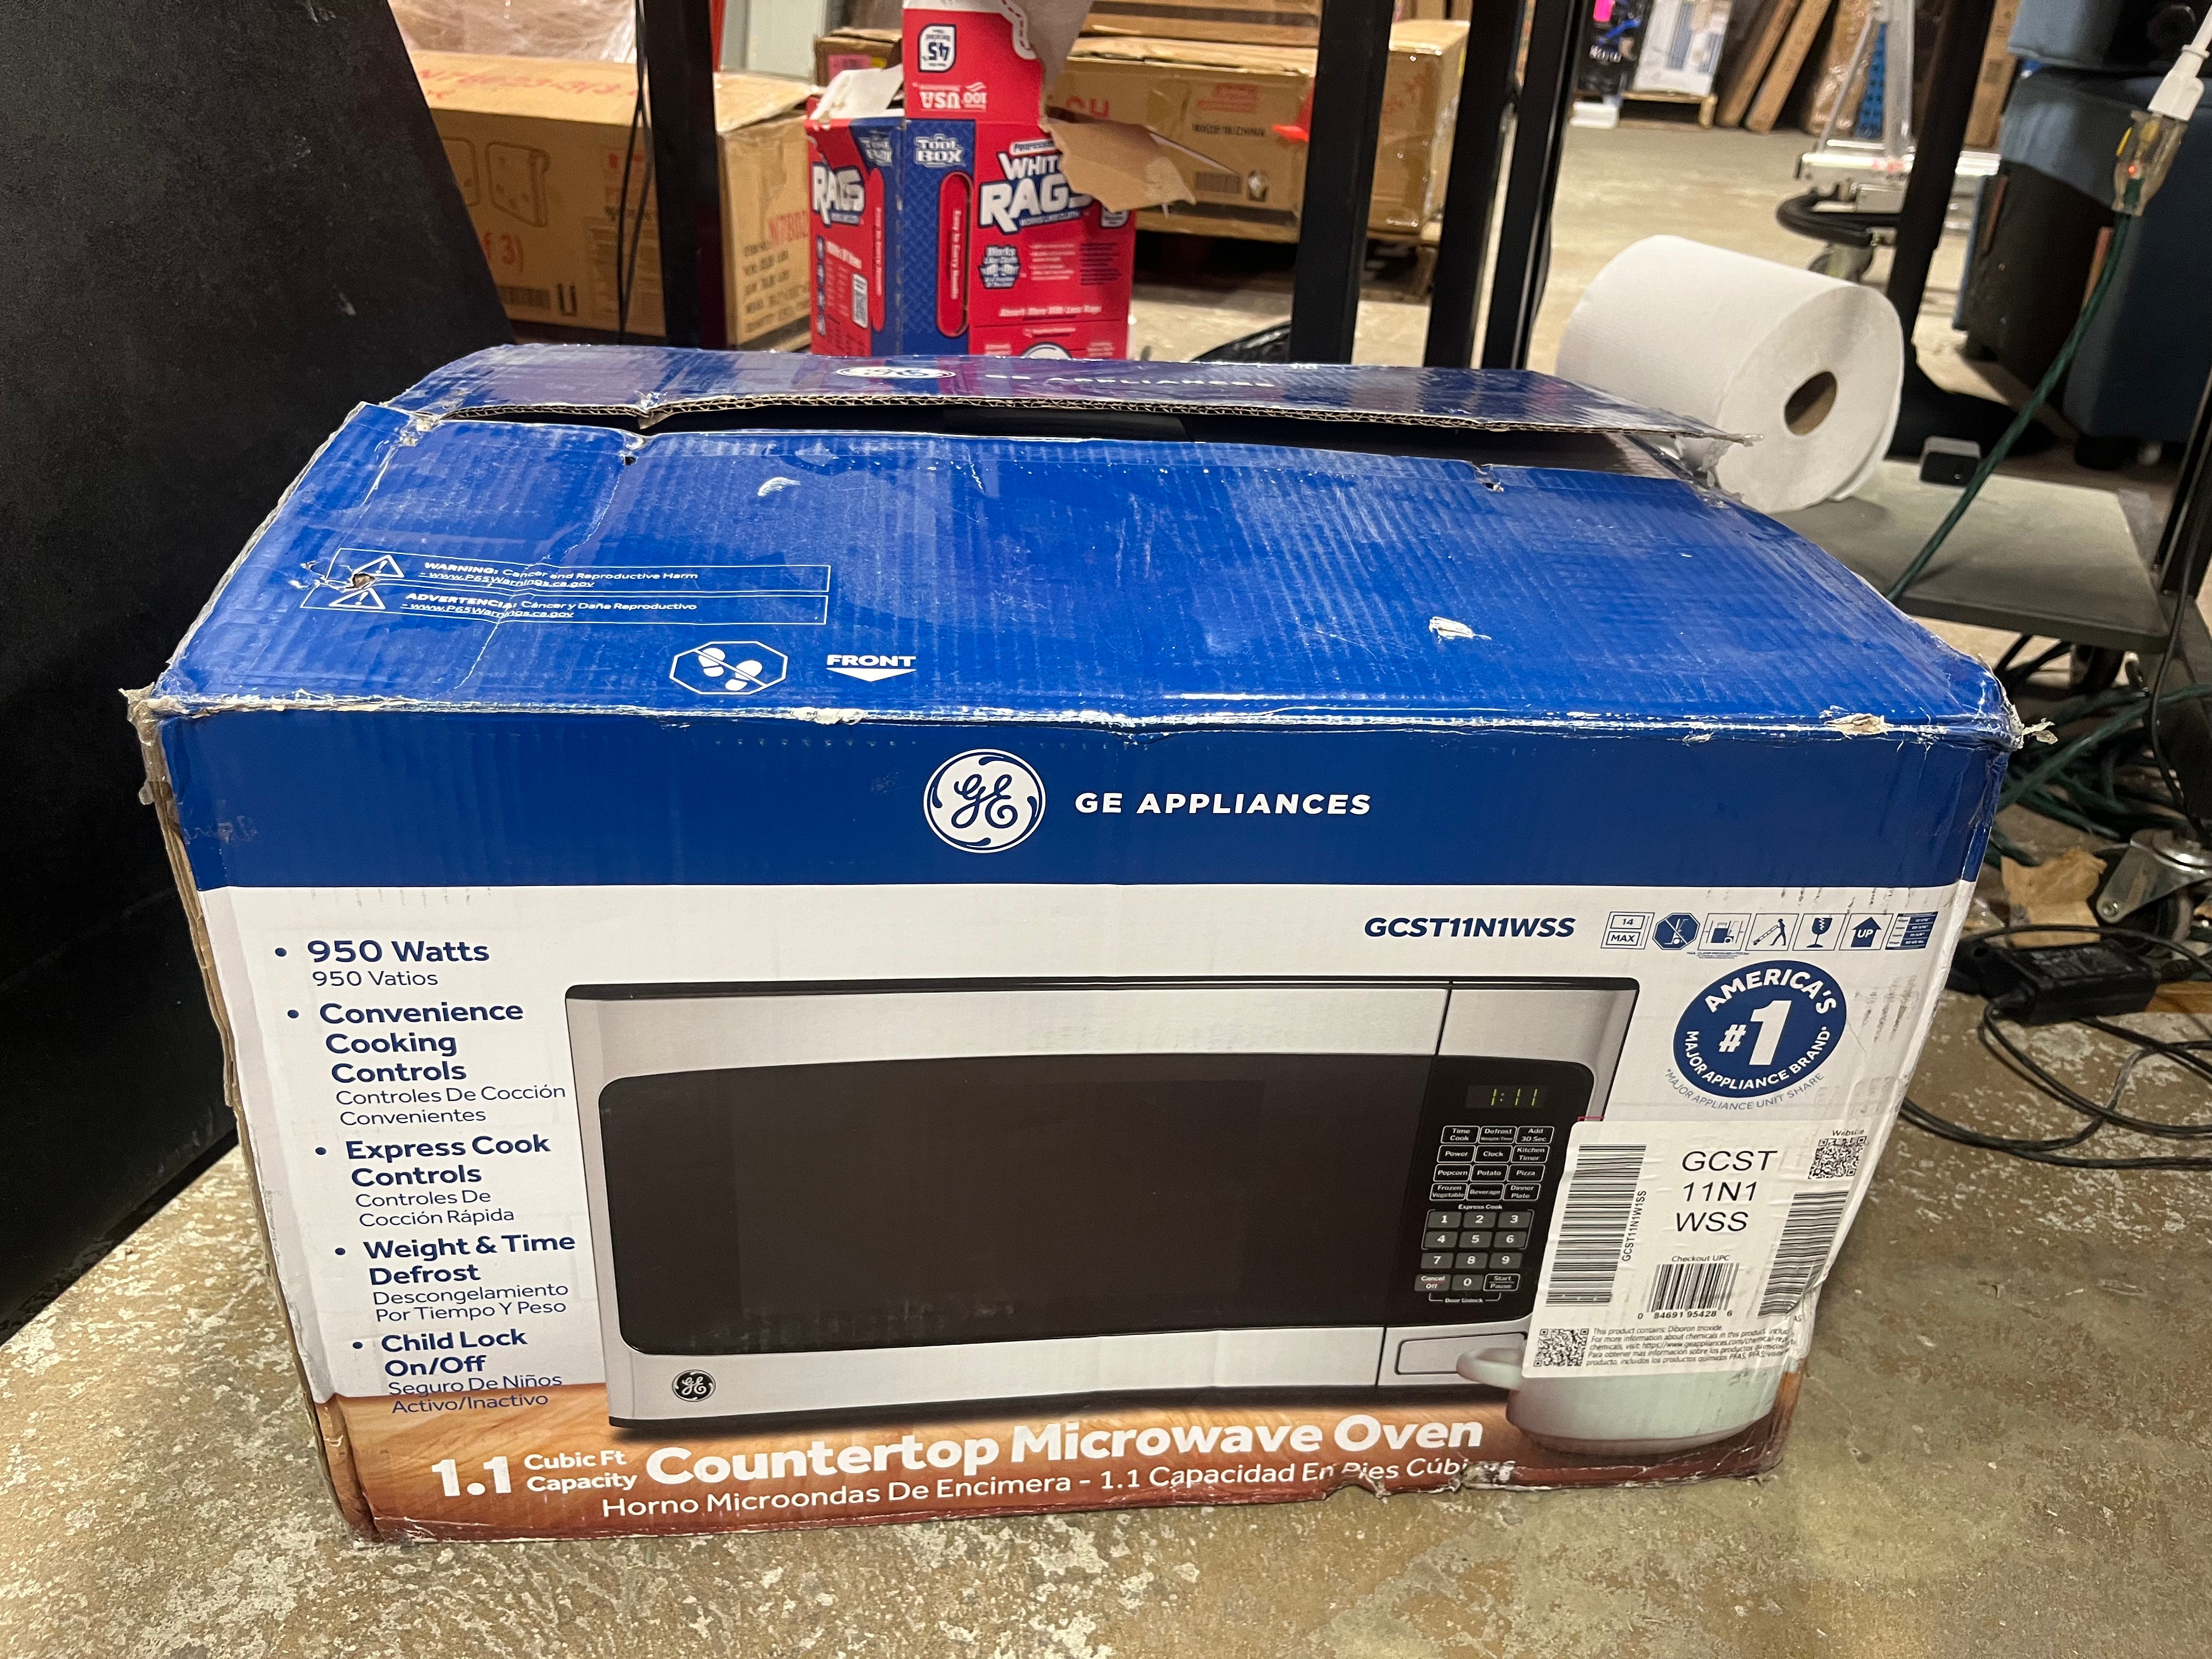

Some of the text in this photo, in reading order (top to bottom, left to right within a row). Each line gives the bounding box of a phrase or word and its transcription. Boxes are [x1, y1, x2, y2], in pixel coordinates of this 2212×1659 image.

[928, 42, 949, 61] 45
[919, 92, 961, 108] USA
[918, 150, 962, 163] BOX
[998, 153, 1059, 180] WHIT
[425, 562, 499, 574] WARNING:
[503, 569, 548, 578] Cancer
[429, 572, 595, 588] www.P65Warnings.ca.gov
[405, 593, 517, 608] ADVERTENCIA:
[411, 603, 574, 619] www.P65Warnings.ca.gov
[827, 654, 916, 667] FRONT
[1075, 792, 1372, 815] GE APPLIANCES
[1364, 917, 1575, 938] GCST11N1WSS
[1611, 933, 1635, 942] MAX
[1857, 929, 1874, 938] UP
[307, 940, 489, 962] 950 Watts
[312, 970, 438, 986] 950 Vatios
[1705, 969, 1836, 1014] AMERICA'S
[320, 1001, 523, 1024] Convenience
[1719, 1000, 1792, 1065] #1
[325, 1032, 458, 1057] Cooking
[1685, 1031, 1709, 1075] MAJOR
[1702, 1069, 1790, 1090] APPLIANCE
[331, 1061, 467, 1083] Controls
[336, 1084, 566, 1105] Controles De Cocción
[1491, 1088, 1538, 1106] 1:11
[1693, 1094, 1753, 1110] APPLIANCE
[1757, 1094, 1784, 1108] UNIT
[1787, 1073, 1824, 1099] SHARE
[340, 1108, 486, 1126] Convenientes
[346, 1134, 551, 1163] Express Cook
[1682, 1150, 1778, 1171] GCST
[351, 1164, 482, 1187] Controls
[356, 1189, 492, 1207] Controles De
[1683, 1181, 1757, 1201] 11N1
[359, 1207, 515, 1227] Cocción Rápida
[1441, 1215, 1448, 1223] 1
[1475, 1215, 1483, 1223] 2
[1510, 1215, 1519, 1223] 3
[1622, 1190, 1646, 1262] GCST11N1W1SS
[1676, 1211, 1748, 1232] WSS
[363, 1234, 575, 1262] Weight & Time
[1437, 1234, 1446, 1243] 4
[1471, 1234, 1480, 1243] 5
[1506, 1234, 1514, 1243] 6
[1433, 1256, 1441, 1264] 7
[1467, 1256, 1476, 1264] 8
[1502, 1256, 1510, 1264] 9
[369, 1263, 482, 1285] Defrost
[1463, 1278, 1472, 1286] 0
[373, 1283, 569, 1306] Descongelamiento
[376, 1301, 567, 1322] Por Tiempo Y Peso
[381, 1328, 528, 1353] Child Lock
[385, 1355, 487, 1377] On/Off
[388, 1373, 562, 1397] Seguro De Niños
[392, 1393, 549, 1414] Activo/Inactivo
[645, 1415, 1483, 1485] Countertop Microwave Oven
[524, 1450, 627, 1472] Cubic Ft
[432, 1456, 511, 1497] 1.1
[526, 1471, 638, 1493] Capacity
[602, 1496, 697, 1517] Horno
[707, 1484, 880, 1513] Microondas
[887, 1481, 929, 1500] De
[936, 1472, 1071, 1498] Encimera
[1101, 1470, 1140, 1491] 1.1
[1149, 1464, 1294, 1490] Capacidad
[1302, 1463, 1334, 1482] En
